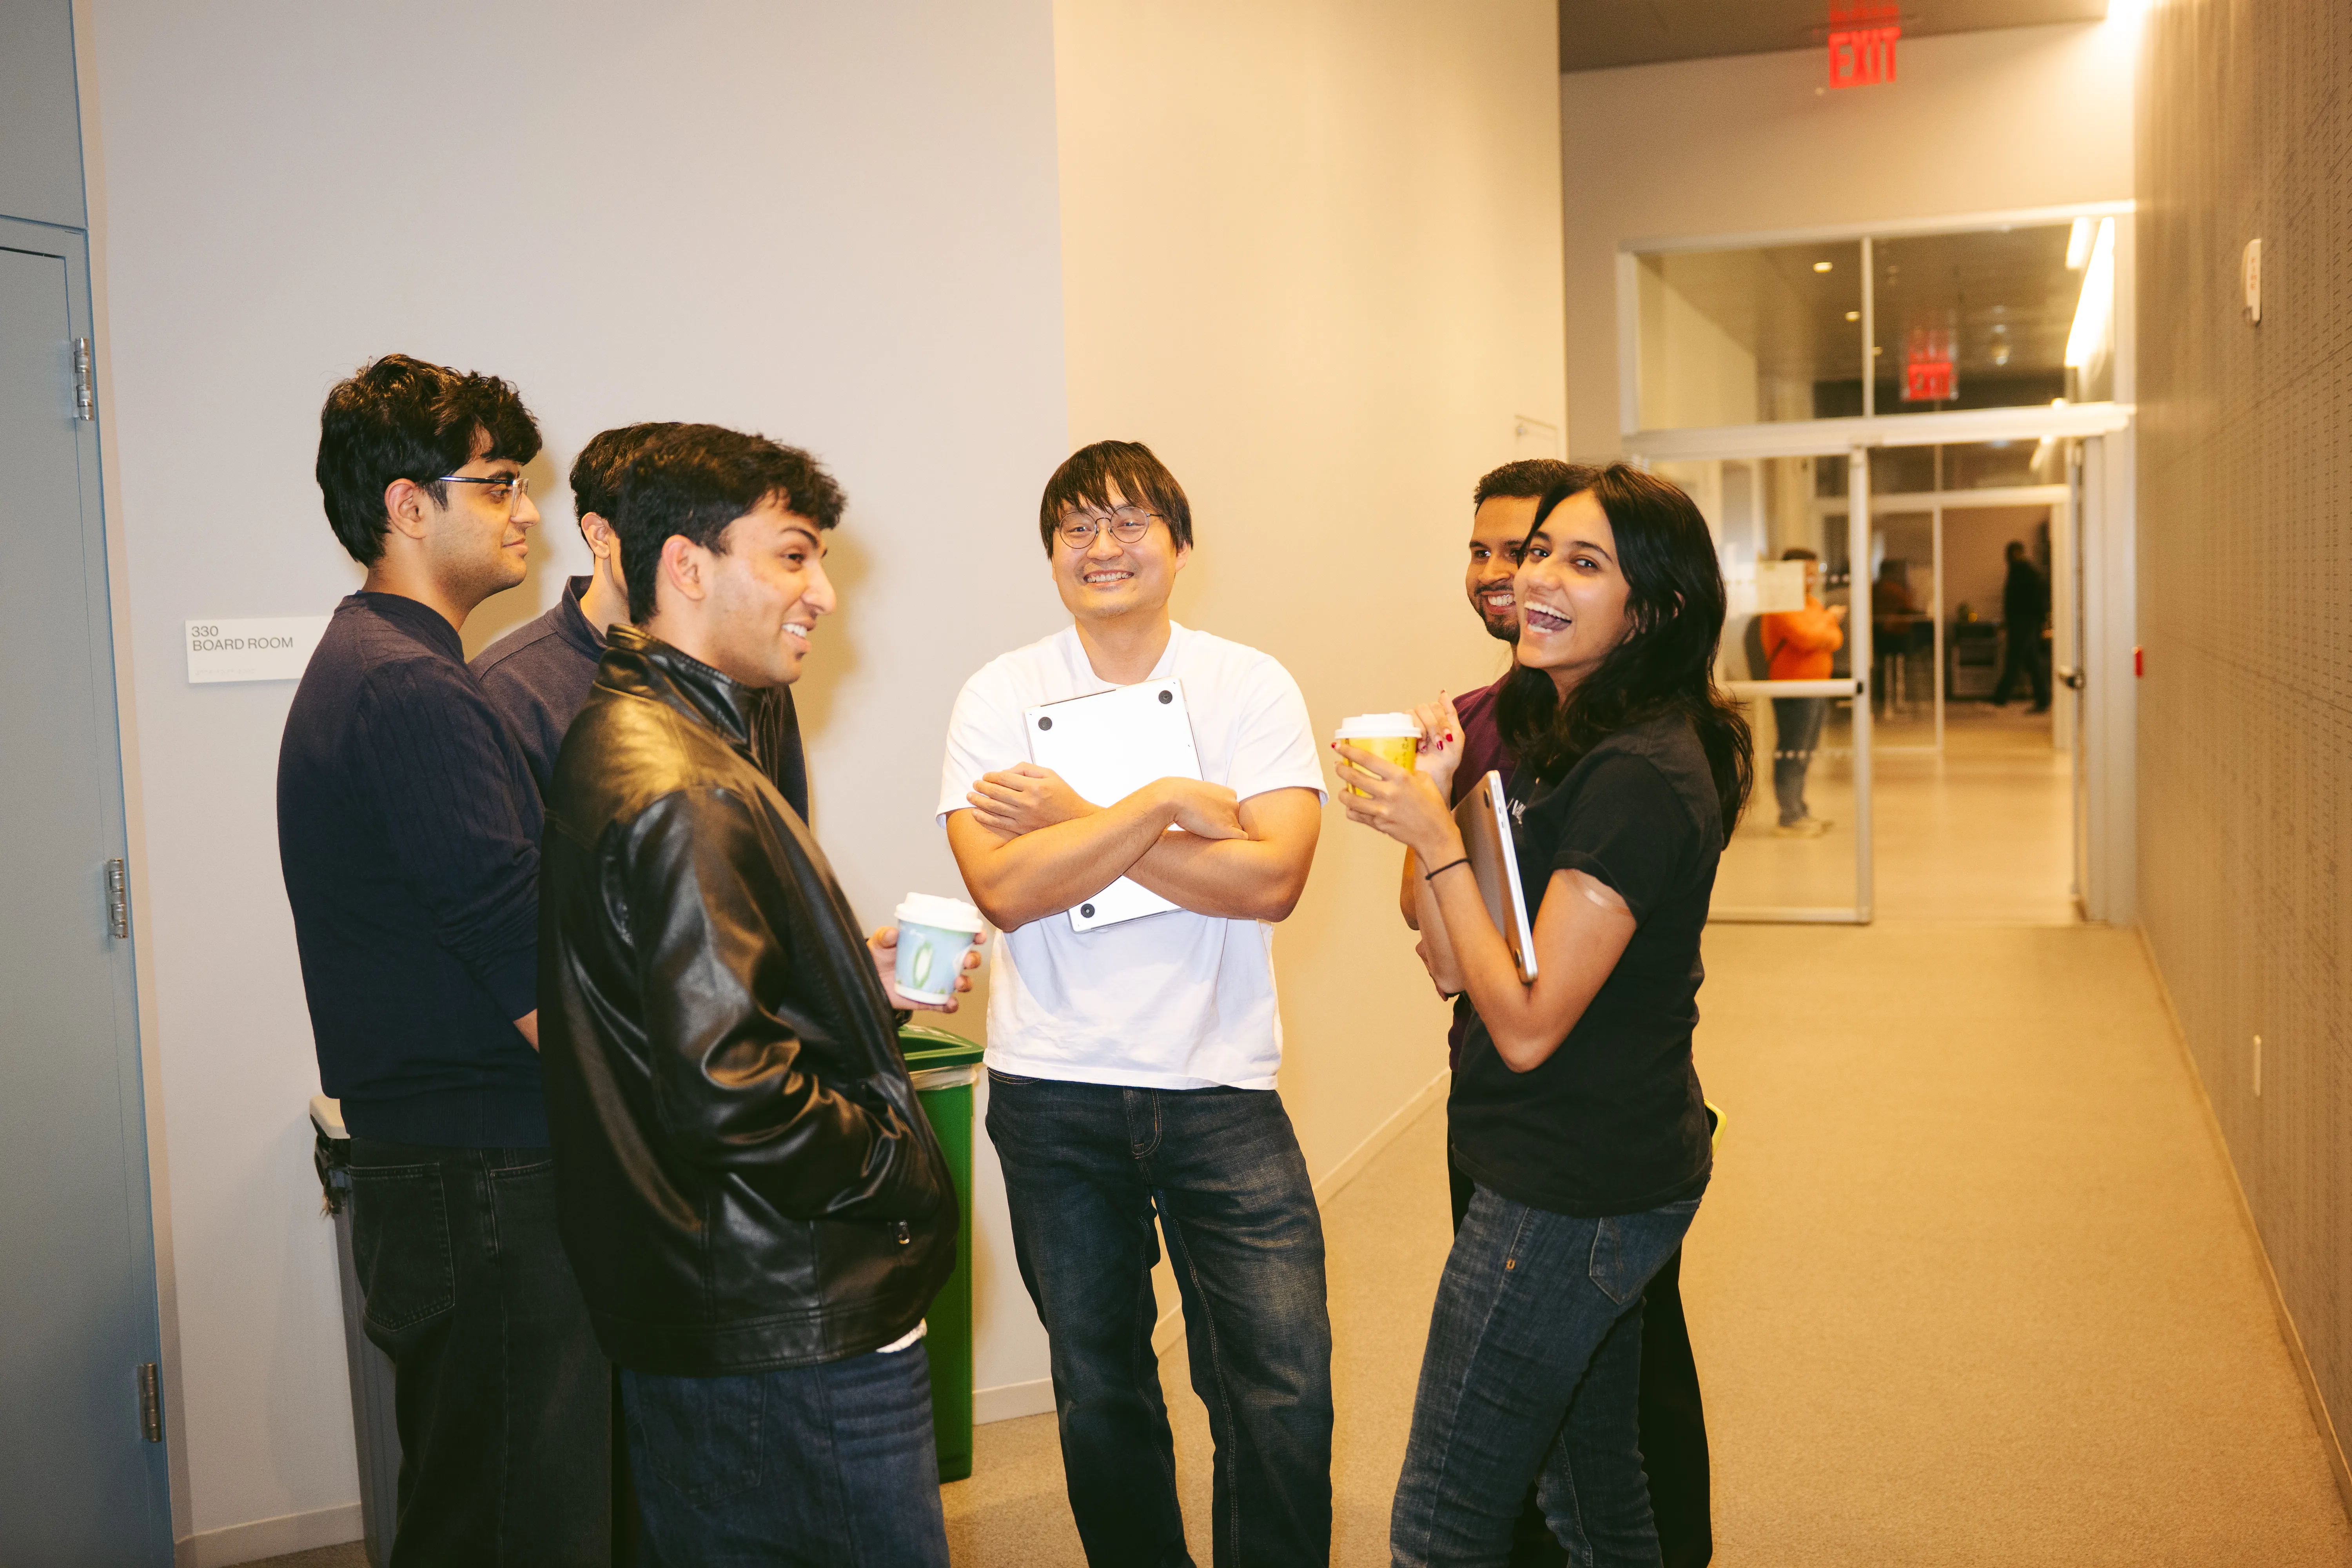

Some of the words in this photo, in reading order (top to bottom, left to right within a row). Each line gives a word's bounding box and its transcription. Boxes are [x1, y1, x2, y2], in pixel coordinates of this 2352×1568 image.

[1828, 27, 1901, 89] EXIT
[192, 626, 218, 637] 330
[193, 639, 244, 651] BOARD
[248, 637, 293, 649] ROOM
